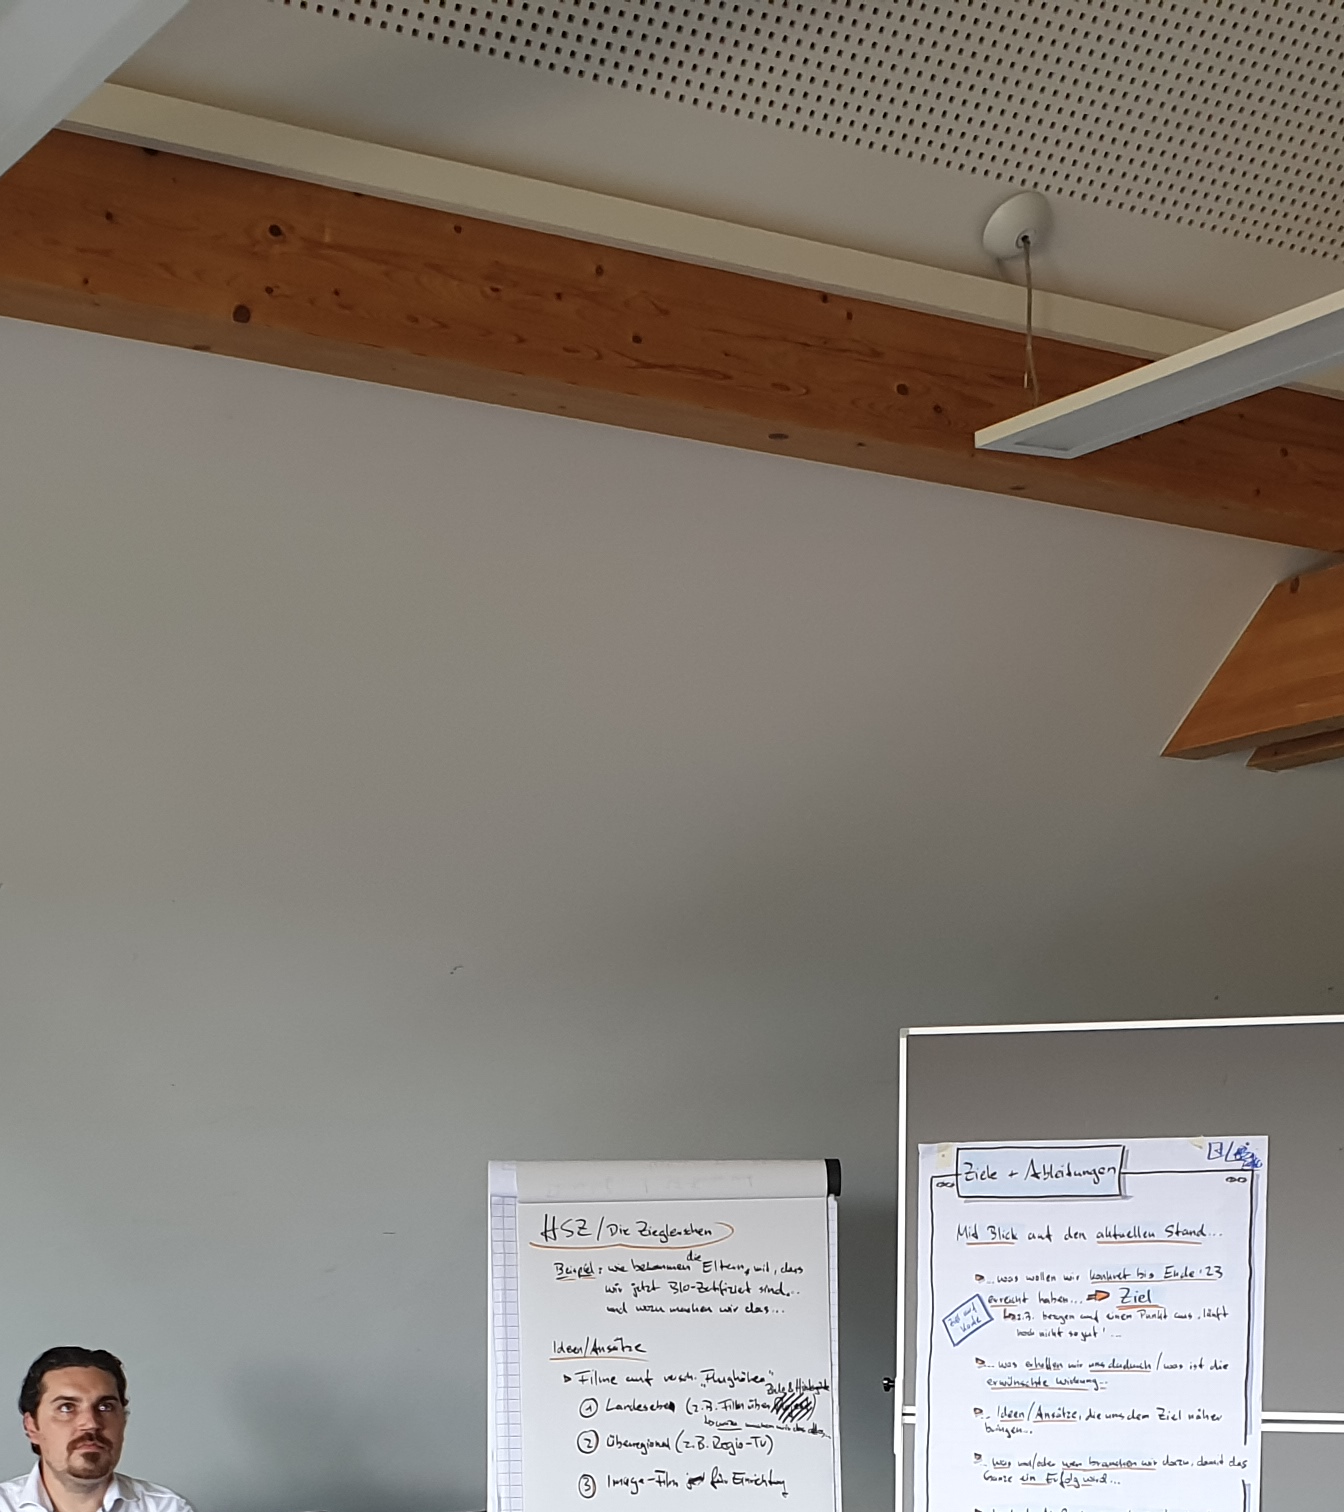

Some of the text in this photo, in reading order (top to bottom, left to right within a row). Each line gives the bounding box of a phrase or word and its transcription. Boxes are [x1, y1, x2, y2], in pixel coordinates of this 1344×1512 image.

[963, 1162, 998, 1184] Ziele
[1024, 1159, 1117, 1184] Ableitungen
[541, 1213, 712, 1243] HSZ Die Zieglerschen
[956, 1223, 980, 1241] Mit
[986, 1225, 1018, 1241] Blick
[1028, 1225, 1052, 1241] auf
[1064, 1226, 1087, 1240] den
[1096, 1224, 1156, 1240] aktuellen
[686, 1250, 702, 1261] die
[607, 1264, 628, 1272] wie
[631, 1259, 691, 1272] bekommen
[1026, 1271, 1056, 1282] wollen
[1064, 1272, 1080, 1281] wir
[1089, 1268, 1131, 1280] konkret
[1137, 1267, 1154, 1279] bis
[1164, 1265, 1194, 1279] Ende
[605, 1282, 622, 1293] wir
[631, 1280, 660, 1298] jetzt
[1119, 1287, 1152, 1304] Ziel
[988, 1292, 1029, 1304] erreicht
[606, 1302, 628, 1314] und
[669, 1303, 713, 1313] machen
[719, 1304, 739, 1313] wir
[1080, 1310, 1099, 1323] auf
[1106, 1311, 1132, 1320] einen
[1137, 1309, 1168, 1320] Punkt
[1039, 1327, 1063, 1337] nicht
[1067, 1360, 1083, 1368] wir
[1190, 1357, 1204, 1371] ist
[1209, 1359, 1229, 1370] die
[625, 1368, 654, 1387] auf
[1085, 1408, 1101, 1421] die
[1105, 1412, 1125, 1420] uns
[1156, 1407, 1181, 1421] Ziel
[1188, 1408, 1223, 1421] näher
[1229, 1456, 1248, 1469] das
[1020, 1473, 1036, 1482] ein
